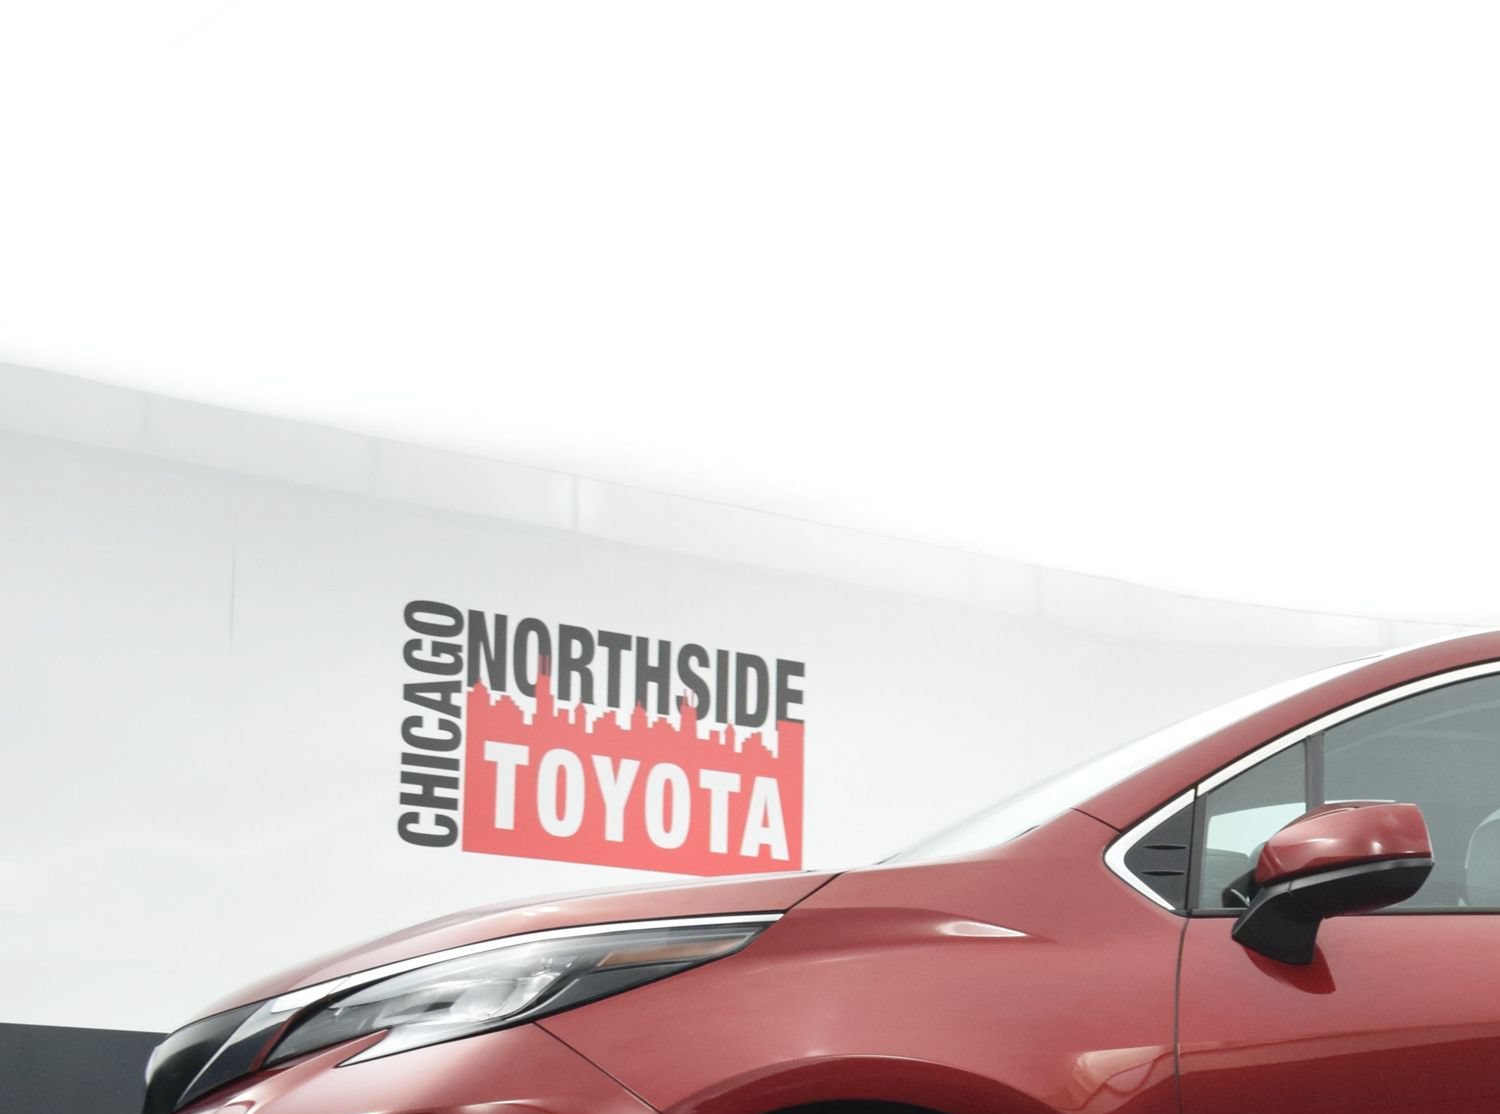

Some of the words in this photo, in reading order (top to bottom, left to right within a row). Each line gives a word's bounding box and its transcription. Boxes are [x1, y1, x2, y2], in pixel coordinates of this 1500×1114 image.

[397, 600, 465, 848] CHICAGO
[467, 609, 806, 728] NORTHSIDE
[484, 740, 790, 861] TOYOTA
